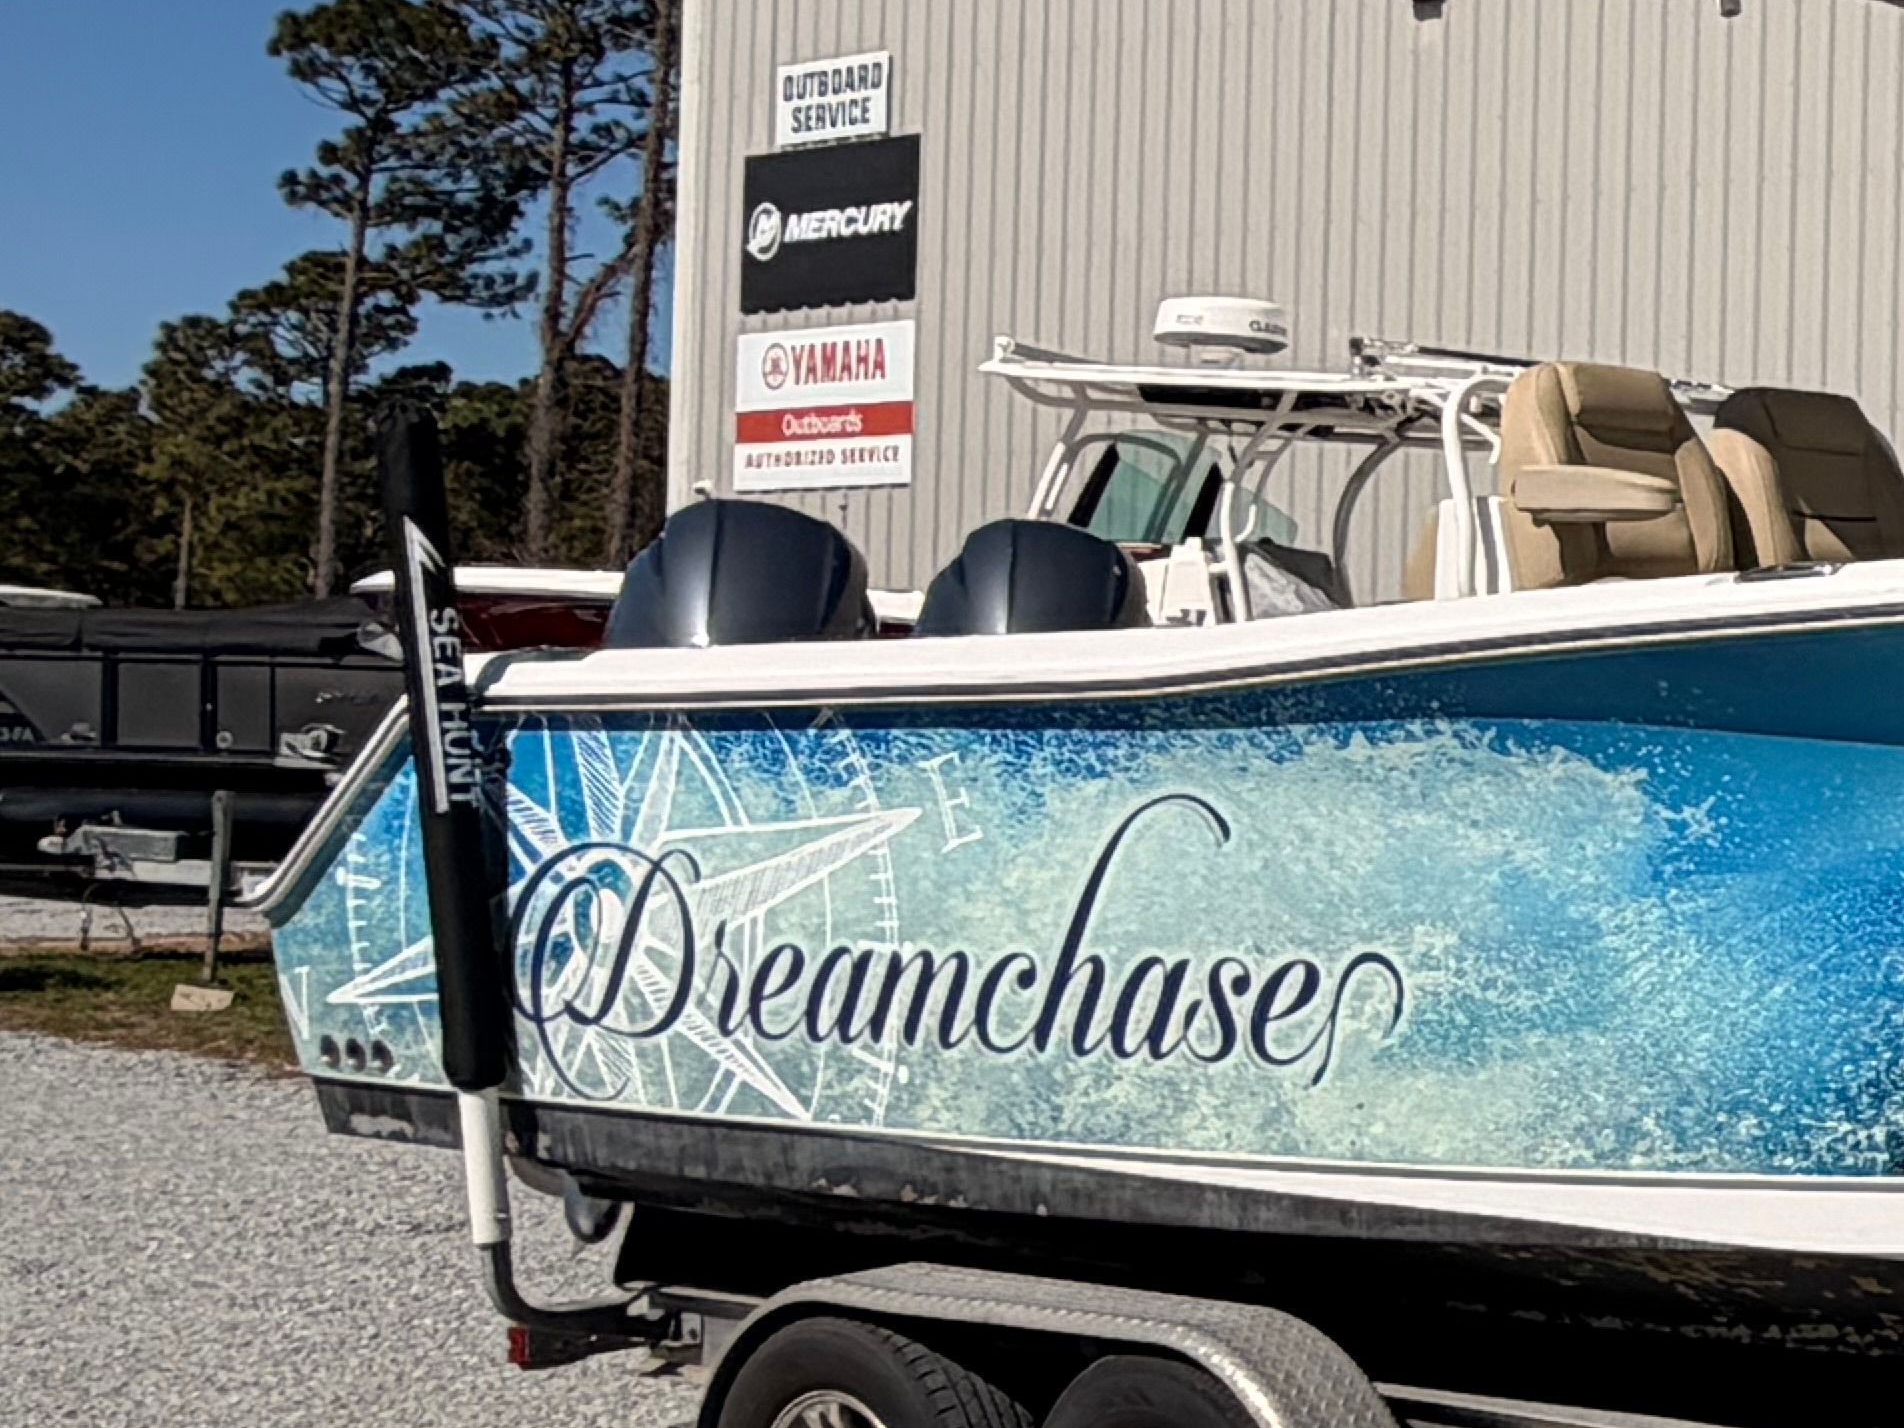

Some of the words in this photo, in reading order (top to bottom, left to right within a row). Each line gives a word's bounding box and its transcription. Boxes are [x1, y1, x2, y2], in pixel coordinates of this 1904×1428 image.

[783, 63, 882, 101] OUTBOARD
[791, 97, 871, 133] SERVICE
[784, 199, 912, 242] MERCURY
[791, 337, 886, 385] YAMAHA
[782, 408, 863, 436] Outboards
[841, 445, 899, 465] SERVICE
[430, 607, 463, 686] SEA
[438, 703, 478, 804] HUNT
